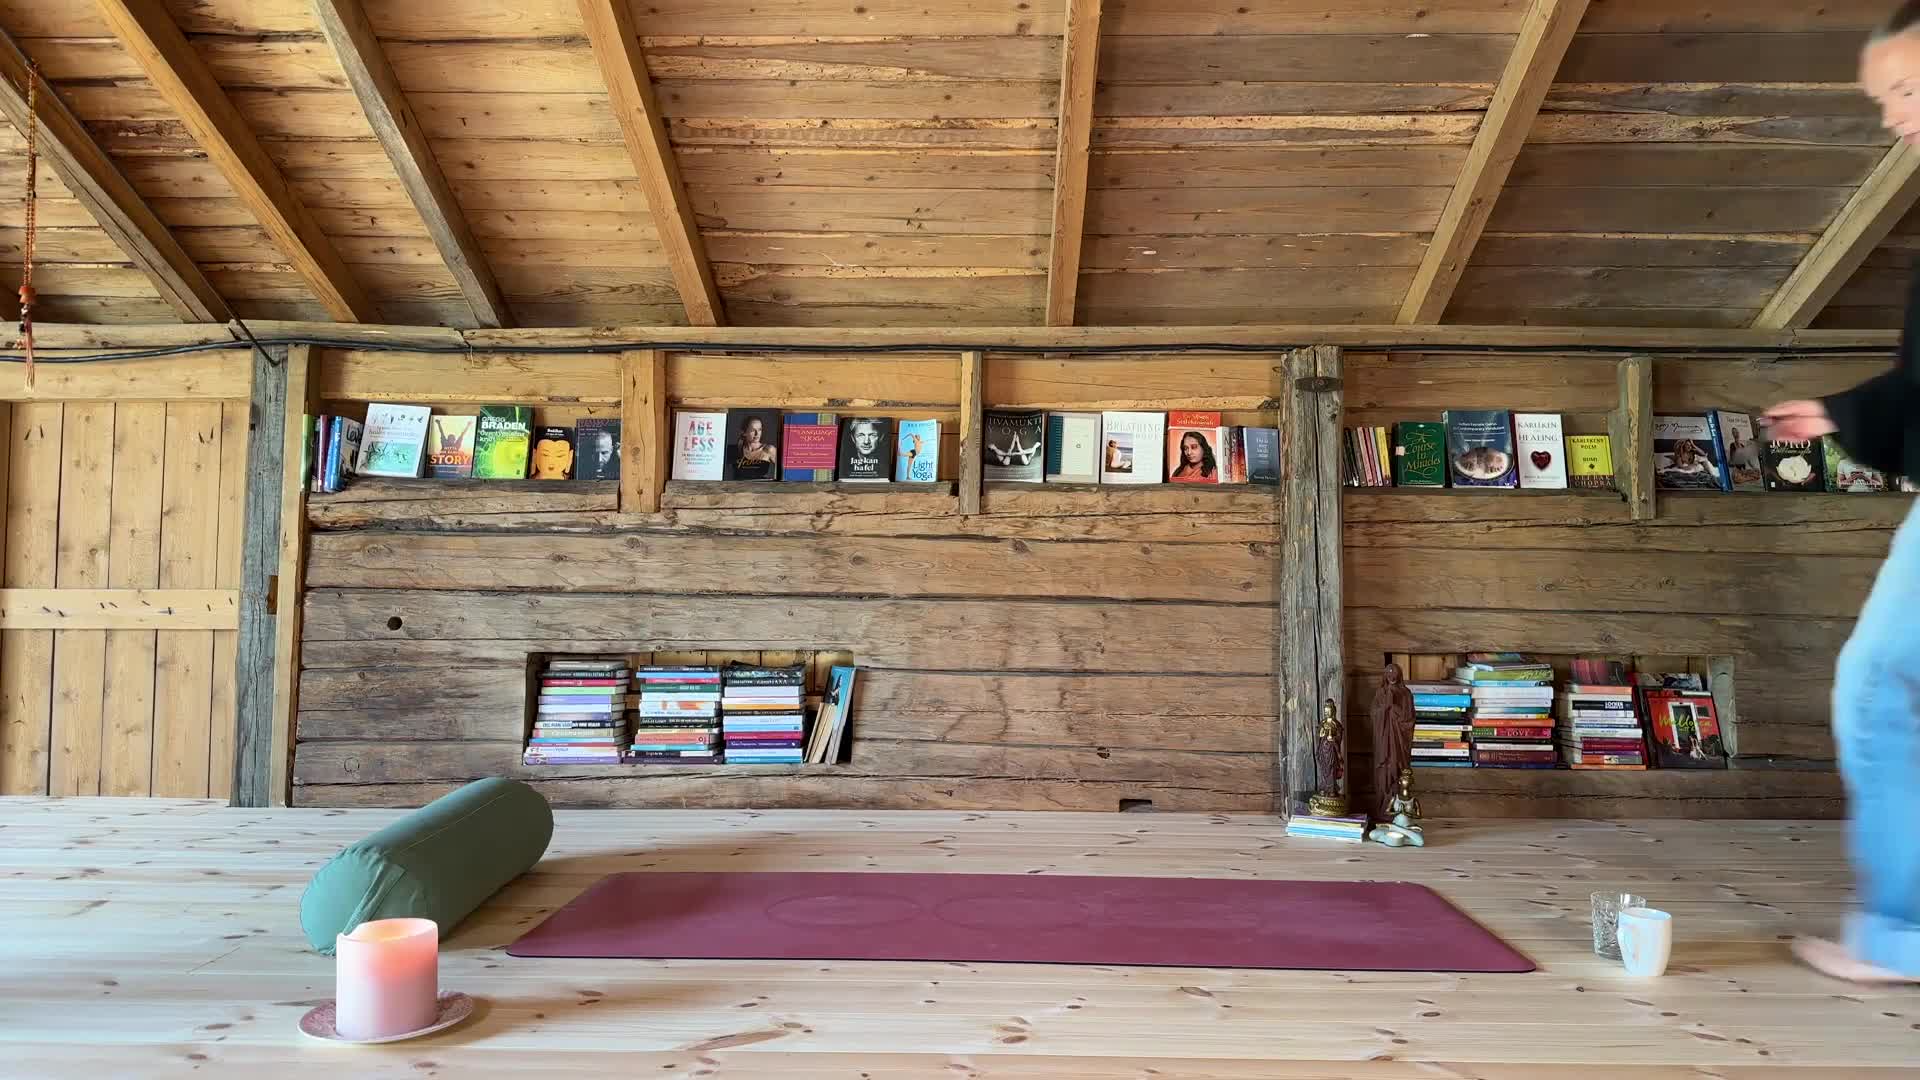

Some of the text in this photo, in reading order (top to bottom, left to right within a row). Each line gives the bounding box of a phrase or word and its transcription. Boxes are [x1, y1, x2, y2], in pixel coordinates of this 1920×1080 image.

[480, 421, 526, 430] BRADEN
[989, 416, 1042, 426] JIVAMUKTI
[688, 420, 712, 436] AGE
[986, 425, 1042, 435] YOGA
[684, 436, 714, 452] LESS
[1405, 440, 1435, 454] Course
[430, 455, 469, 464] STORY
[850, 457, 863, 466] Jag
[1407, 456, 1441, 470] Miracles
[913, 460, 933, 471] Light
[912, 468, 933, 480] Yoga
